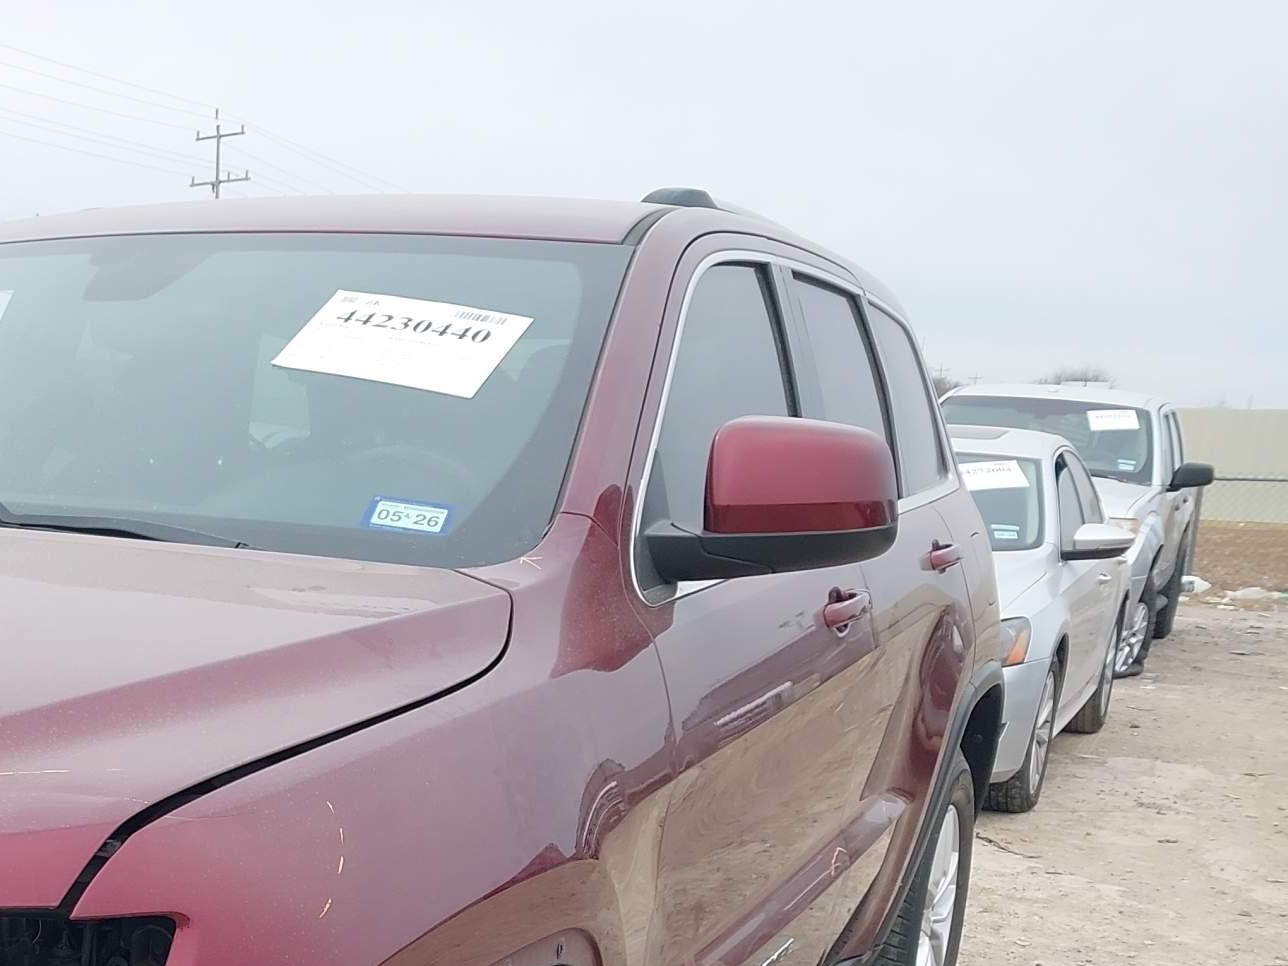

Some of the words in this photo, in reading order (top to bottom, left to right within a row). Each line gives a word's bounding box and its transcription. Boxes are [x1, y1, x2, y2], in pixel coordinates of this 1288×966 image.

[336, 310, 492, 344] 44230440
[377, 508, 405, 522] 05
[412, 513, 441, 528] 26
